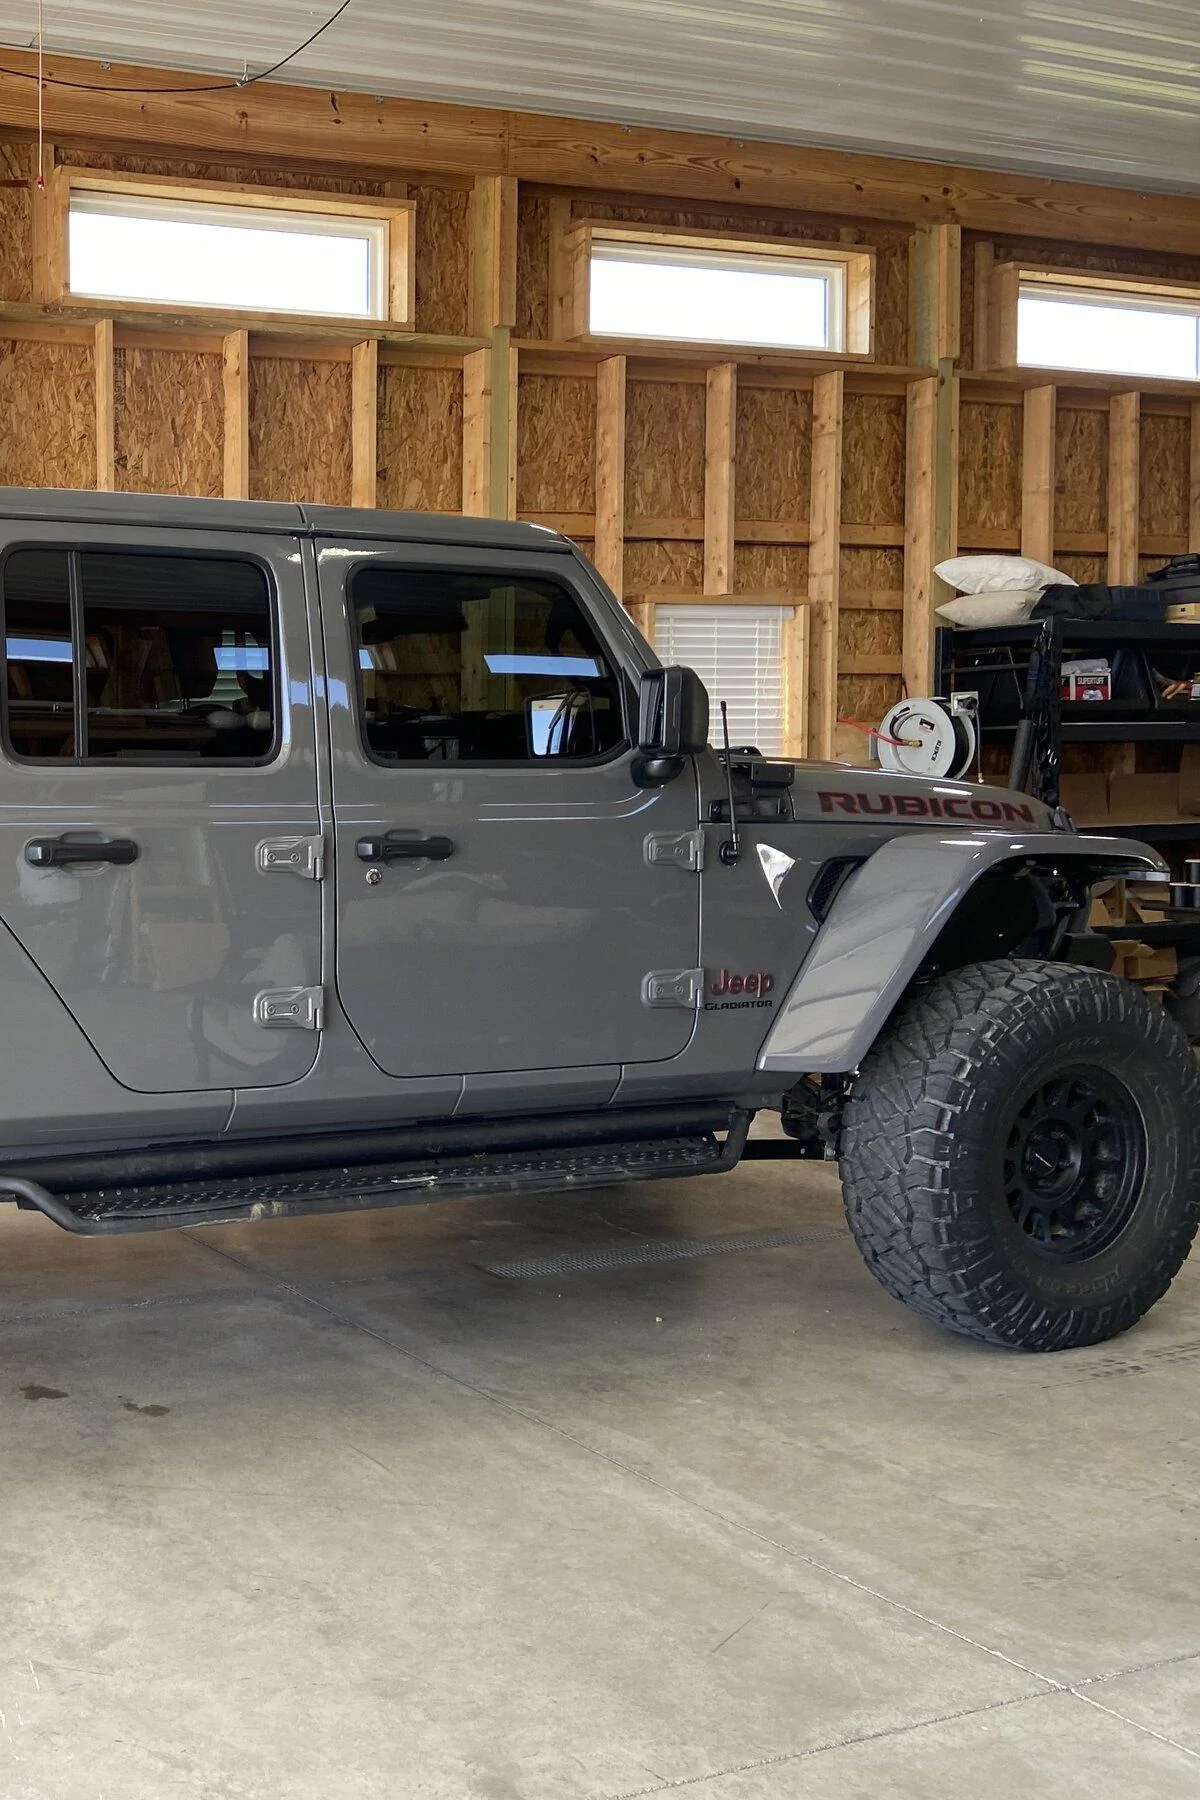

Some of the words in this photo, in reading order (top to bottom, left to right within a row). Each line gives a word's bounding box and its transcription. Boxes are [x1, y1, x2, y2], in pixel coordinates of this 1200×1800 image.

[1077, 676, 1105, 685] SUPERTUFF
[816, 791, 1036, 824] RUBICON
[709, 968, 775, 998] Jeep
[704, 1000, 773, 1011] GLADIATOR
